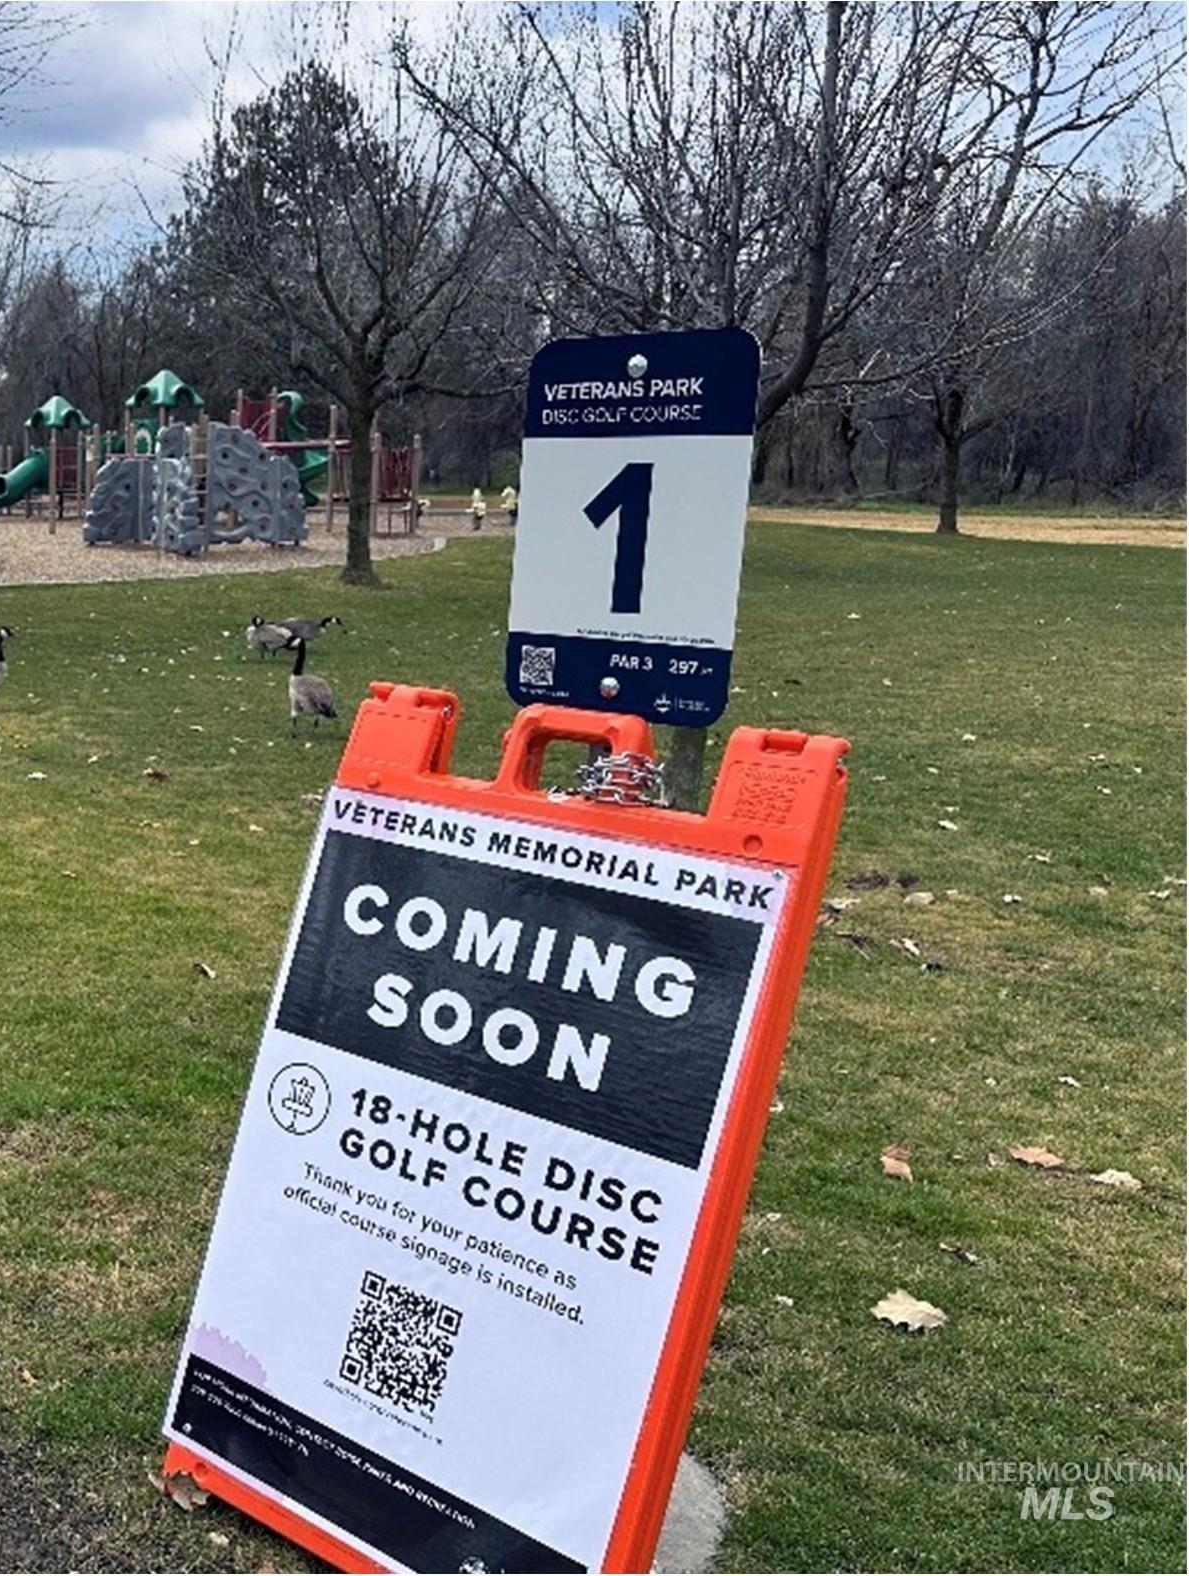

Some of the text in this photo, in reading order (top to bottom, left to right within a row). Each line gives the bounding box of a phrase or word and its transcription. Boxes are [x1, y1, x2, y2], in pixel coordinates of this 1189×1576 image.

[542, 404, 702, 425] DISC GOLF COURSE
[544, 376, 704, 402] VETERANS PARK
[582, 463, 654, 613] 1
[610, 654, 640, 670] PAR
[642, 656, 653, 671] 3
[668, 659, 699, 675] 297
[332, 799, 775, 910] VETERANS MEMORIAL PARK
[343, 884, 696, 1019] COMING
[367, 973, 611, 1092] SOON
[339, 1127, 661, 1276] GOLF COURSE
[351, 1088, 663, 1224] 18-HOLE DISC
[283, 1186, 585, 1326] official course signage is installed.
[303, 1161, 578, 1291] Thank you for your patience as
